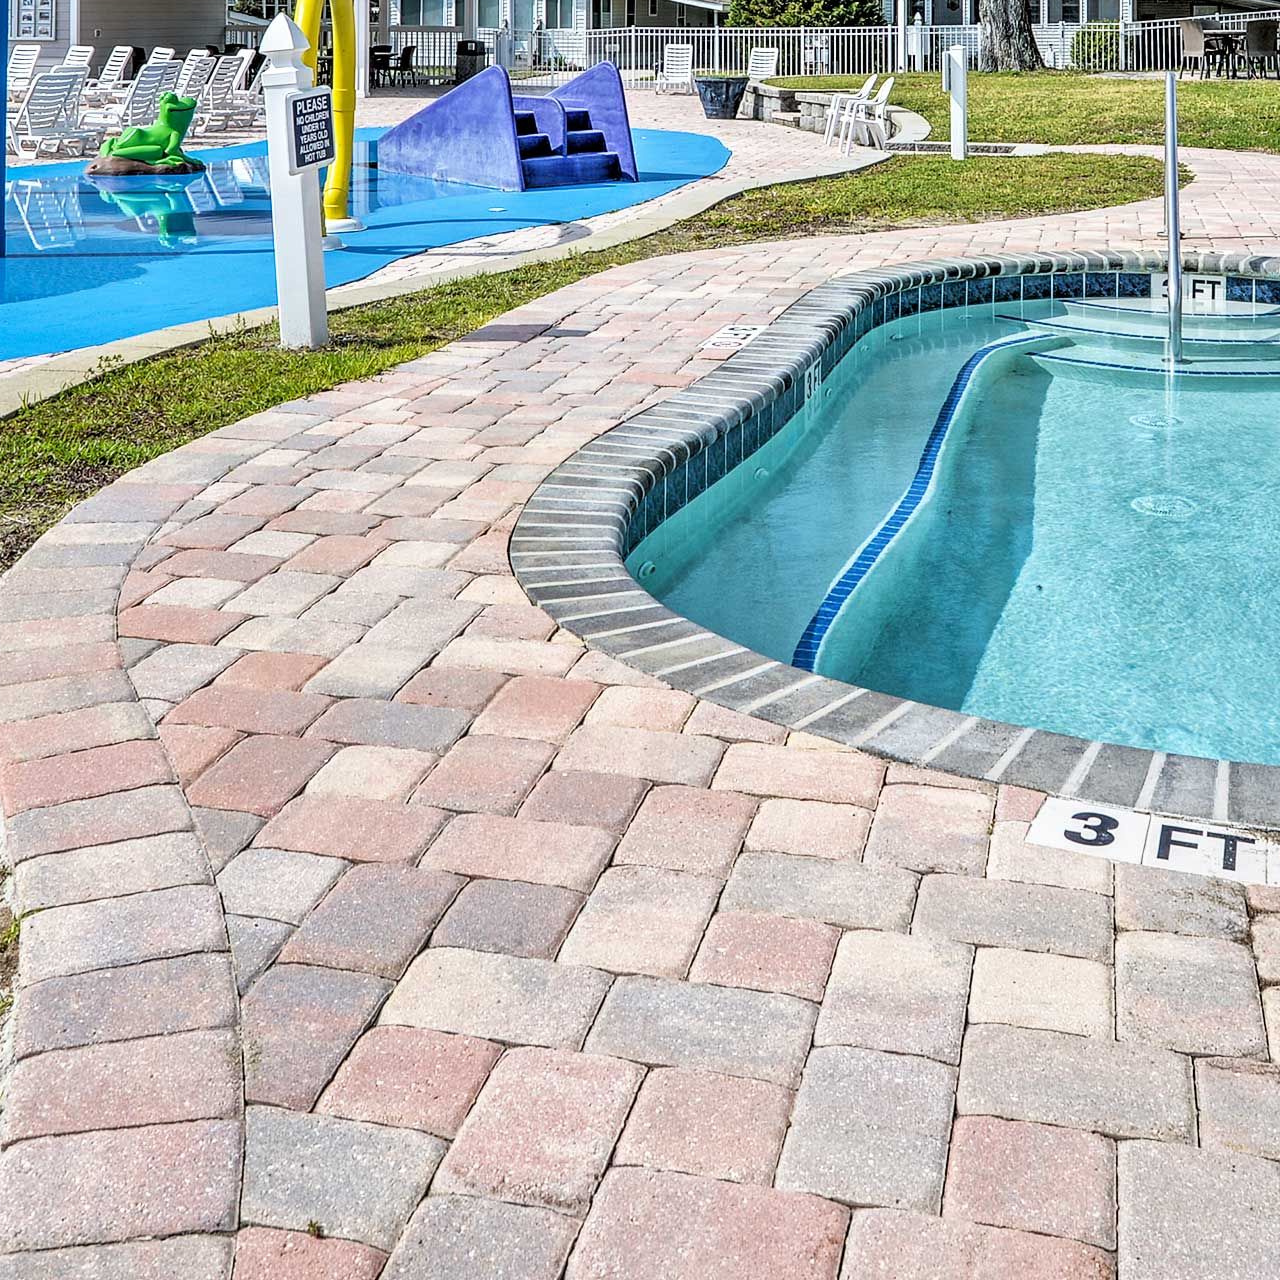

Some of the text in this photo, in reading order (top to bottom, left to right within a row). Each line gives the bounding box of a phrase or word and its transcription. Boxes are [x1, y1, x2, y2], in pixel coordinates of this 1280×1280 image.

[296, 96, 328, 115] PLEASE
[296, 110, 330, 126] NO CHILDREN
[301, 121, 326, 134] UNDER 12
[300, 129, 328, 144] YEARS OLD
[300, 138, 330, 155] ALLOWED IN
[305, 149, 327, 163] HOT TUB
[1192, 279, 1222, 300] FT
[1063, 811, 1256, 871] 3 FT
